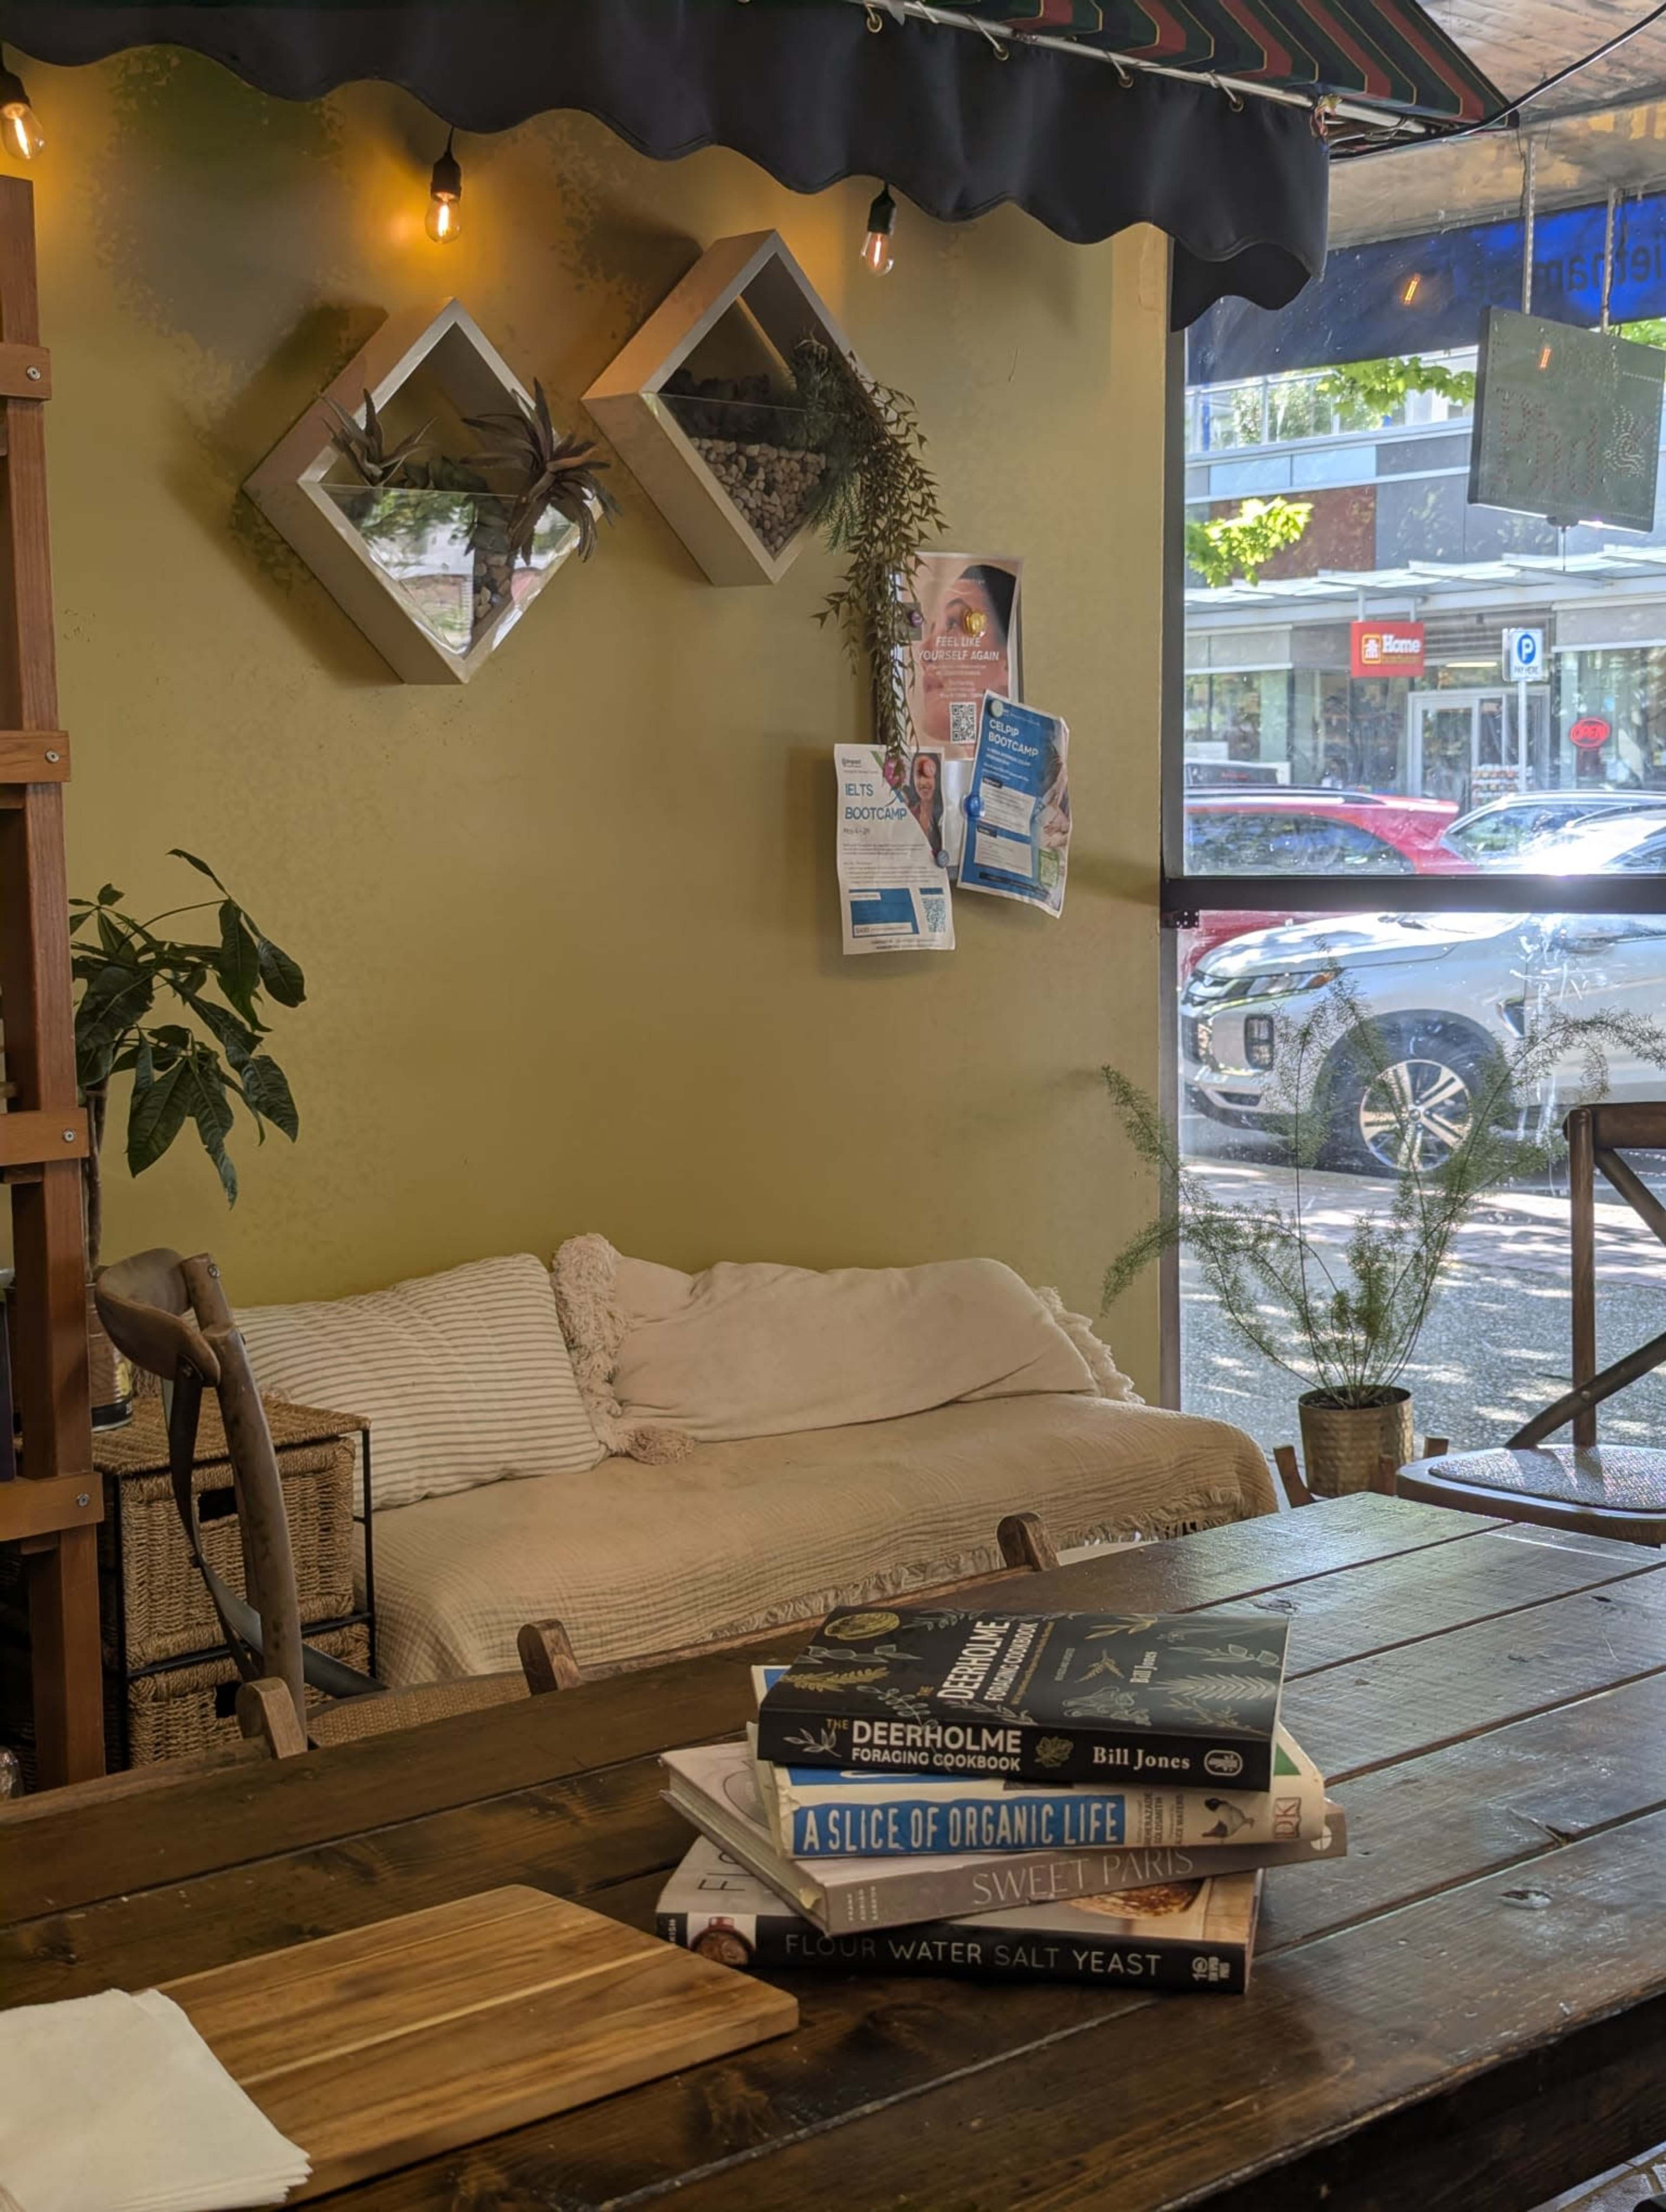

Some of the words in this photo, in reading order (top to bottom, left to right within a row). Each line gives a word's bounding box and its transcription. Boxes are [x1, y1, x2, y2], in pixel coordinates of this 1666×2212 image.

[936, 636, 960, 647] FEEL
[961, 637, 981, 647] LIKE
[1382, 635, 1420, 653] Home
[919, 650, 968, 660] YOURSELF
[971, 651, 1000, 661] AGAIN
[989, 719, 1020, 737] CELPIP
[988, 732, 1039, 757] BOOTCAMP
[845, 783, 874, 797] IELTS
[845, 807, 907, 821] BOOTCAMP
[937, 1620, 1011, 1700] DEERHOLME
[826, 1719, 849, 1729] THE
[853, 1720, 1022, 1753] DEERHOLME
[851, 1747, 930, 1765] FORAGING
[933, 1753, 1021, 1771] COOKBOOK
[1093, 1746, 1128, 1765] Bill
[1133, 1750, 1190, 1770] Jones
[803, 1810, 820, 1851] A
[828, 1808, 901, 1852] SLICE
[910, 1806, 940, 1849] OF
[948, 1803, 1054, 1848] ORGANIC
[1063, 1801, 1120, 1845] LIFE
[1276, 1797, 1297, 1838] DK
[972, 1859, 1089, 1905] SWEET
[1103, 1849, 1193, 1886] PARIS
[785, 1934, 876, 1958] FLOUR
[888, 1939, 983, 1964] WATER
[994, 1945, 1059, 1968] SALT
[1072, 1950, 1161, 1976] YEAST
